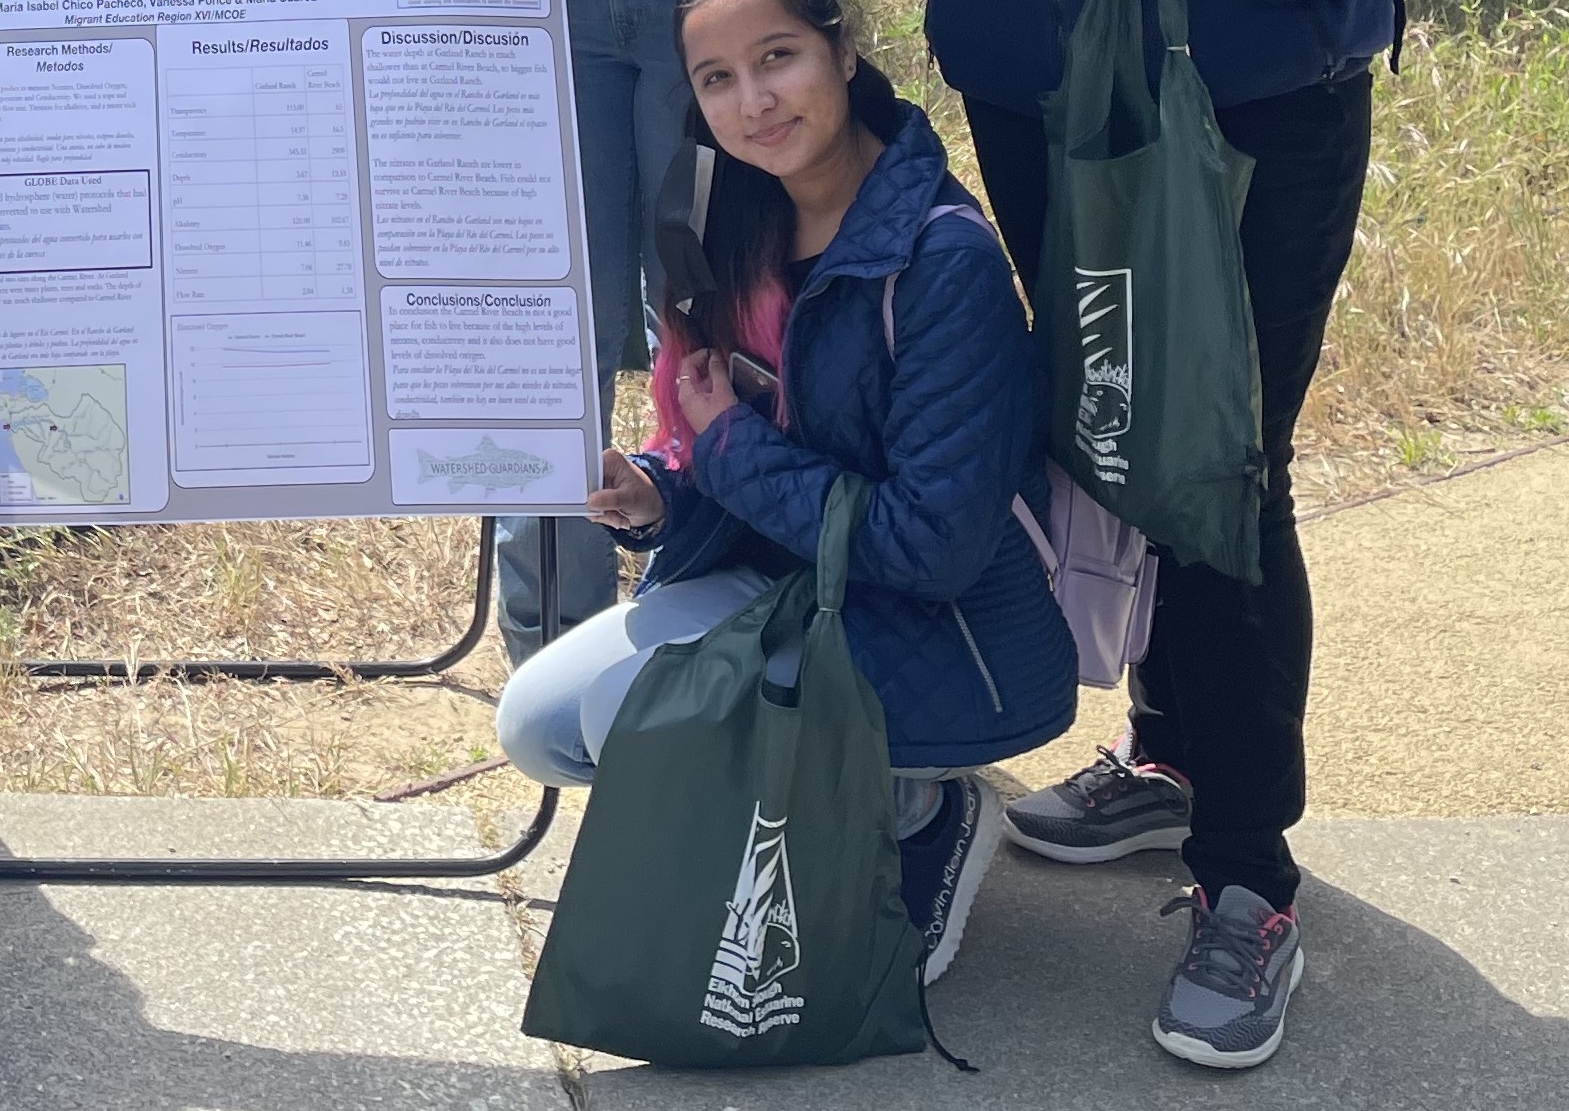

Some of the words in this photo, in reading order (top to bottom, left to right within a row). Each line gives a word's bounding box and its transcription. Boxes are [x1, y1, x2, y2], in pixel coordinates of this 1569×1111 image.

[26, 0, 58, 11] Isabel
[62, 0, 93, 10] Chico
[64, 14, 102, 26] Migrant
[105, 12, 154, 23] Education
[194, 9, 245, 19] XVI/MCOE
[192, 36, 328, 54] Results/Resultados
[381, 32, 529, 45] Discussion/Discusión
[6, 45, 58, 56] Research
[61, 42, 112, 54] Methods/
[373, 159, 387, 167] The
[24, 177, 57, 186] GLOBE
[59, 176, 78, 185] Data
[81, 176, 101, 184] Used
[406, 293, 551, 306] Conclusions/Conclusión
[431, 464, 487, 474] WATERSHED
[488, 464, 540, 474] GUARDIANS
[924, 888, 951, 950] Calvin
[942, 838, 967, 888] Klein
[960, 776, 976, 838] Jean
